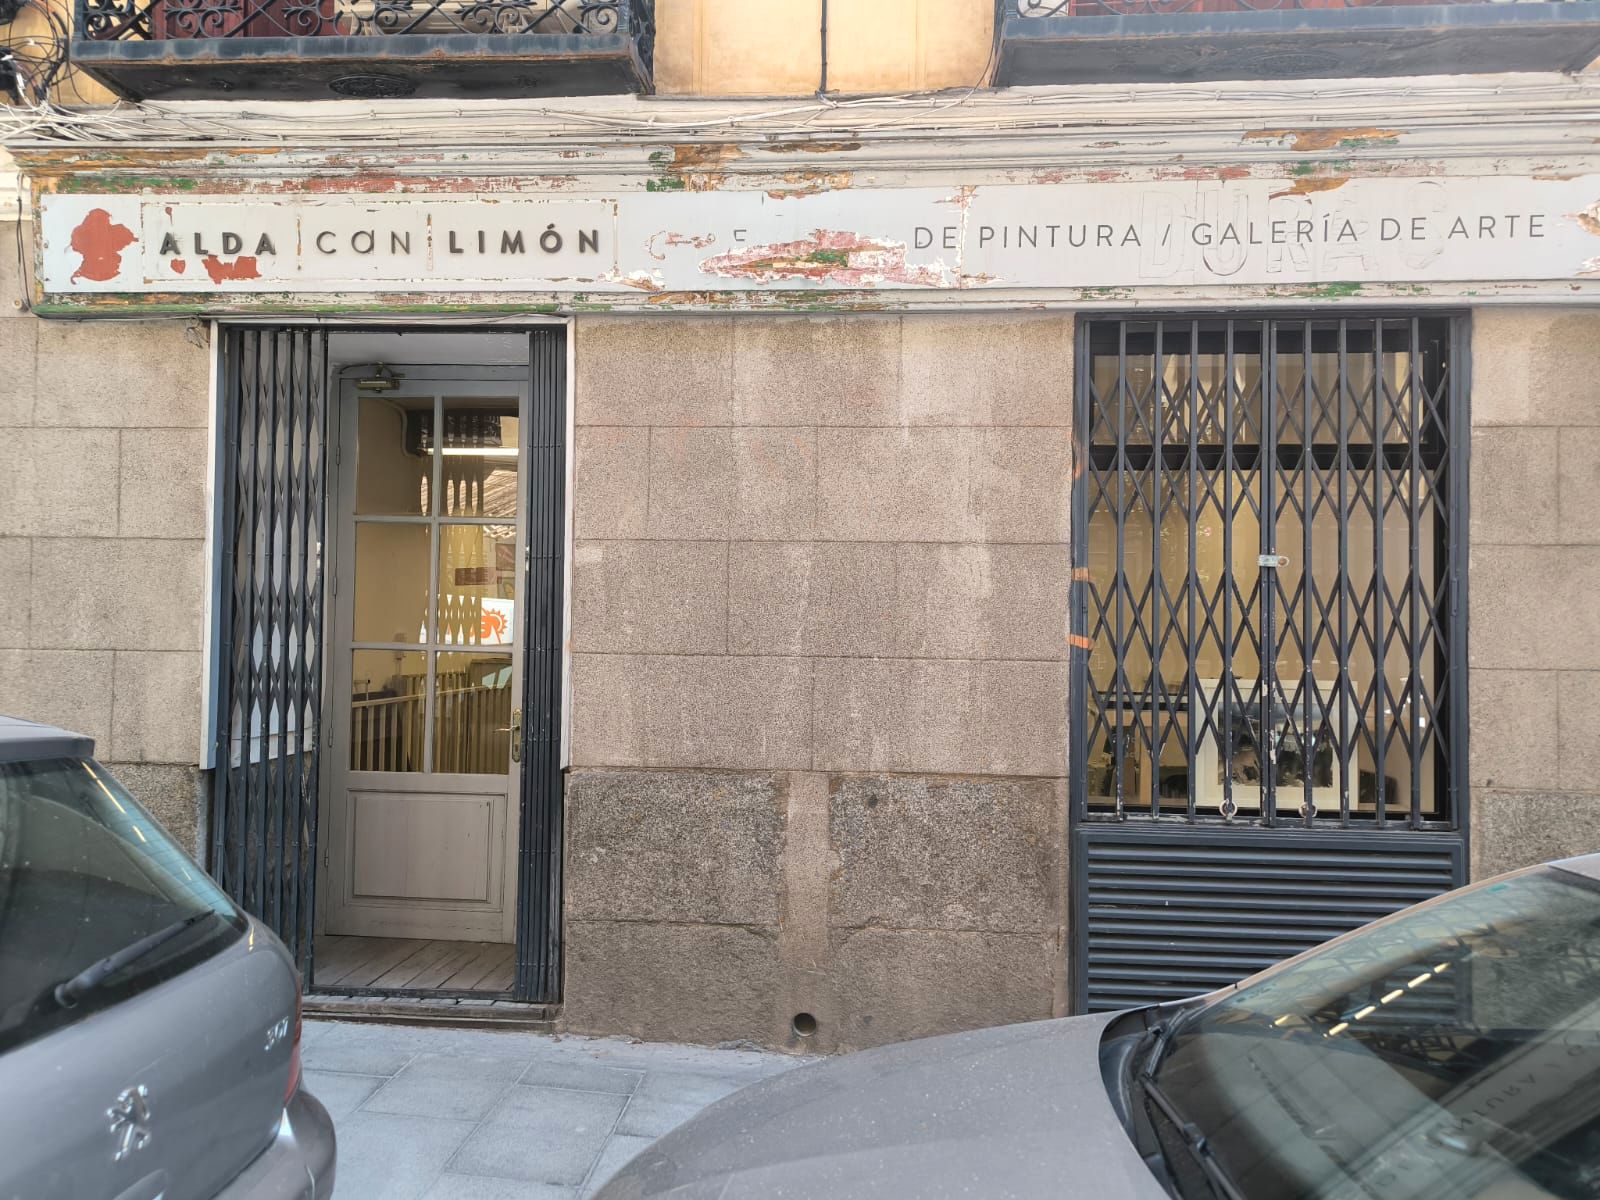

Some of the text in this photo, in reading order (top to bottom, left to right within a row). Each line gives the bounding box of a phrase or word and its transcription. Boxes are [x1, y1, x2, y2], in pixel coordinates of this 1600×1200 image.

[160, 231, 276, 256] ALDA
[448, 223, 600, 254] LIMÓN
[914, 226, 957, 249] DE
[979, 224, 1143, 249] PINTURA
[1191, 213, 1358, 246] GALERÍA
[1381, 216, 1428, 241] DE
[1447, 214, 1546, 240] ARTE
